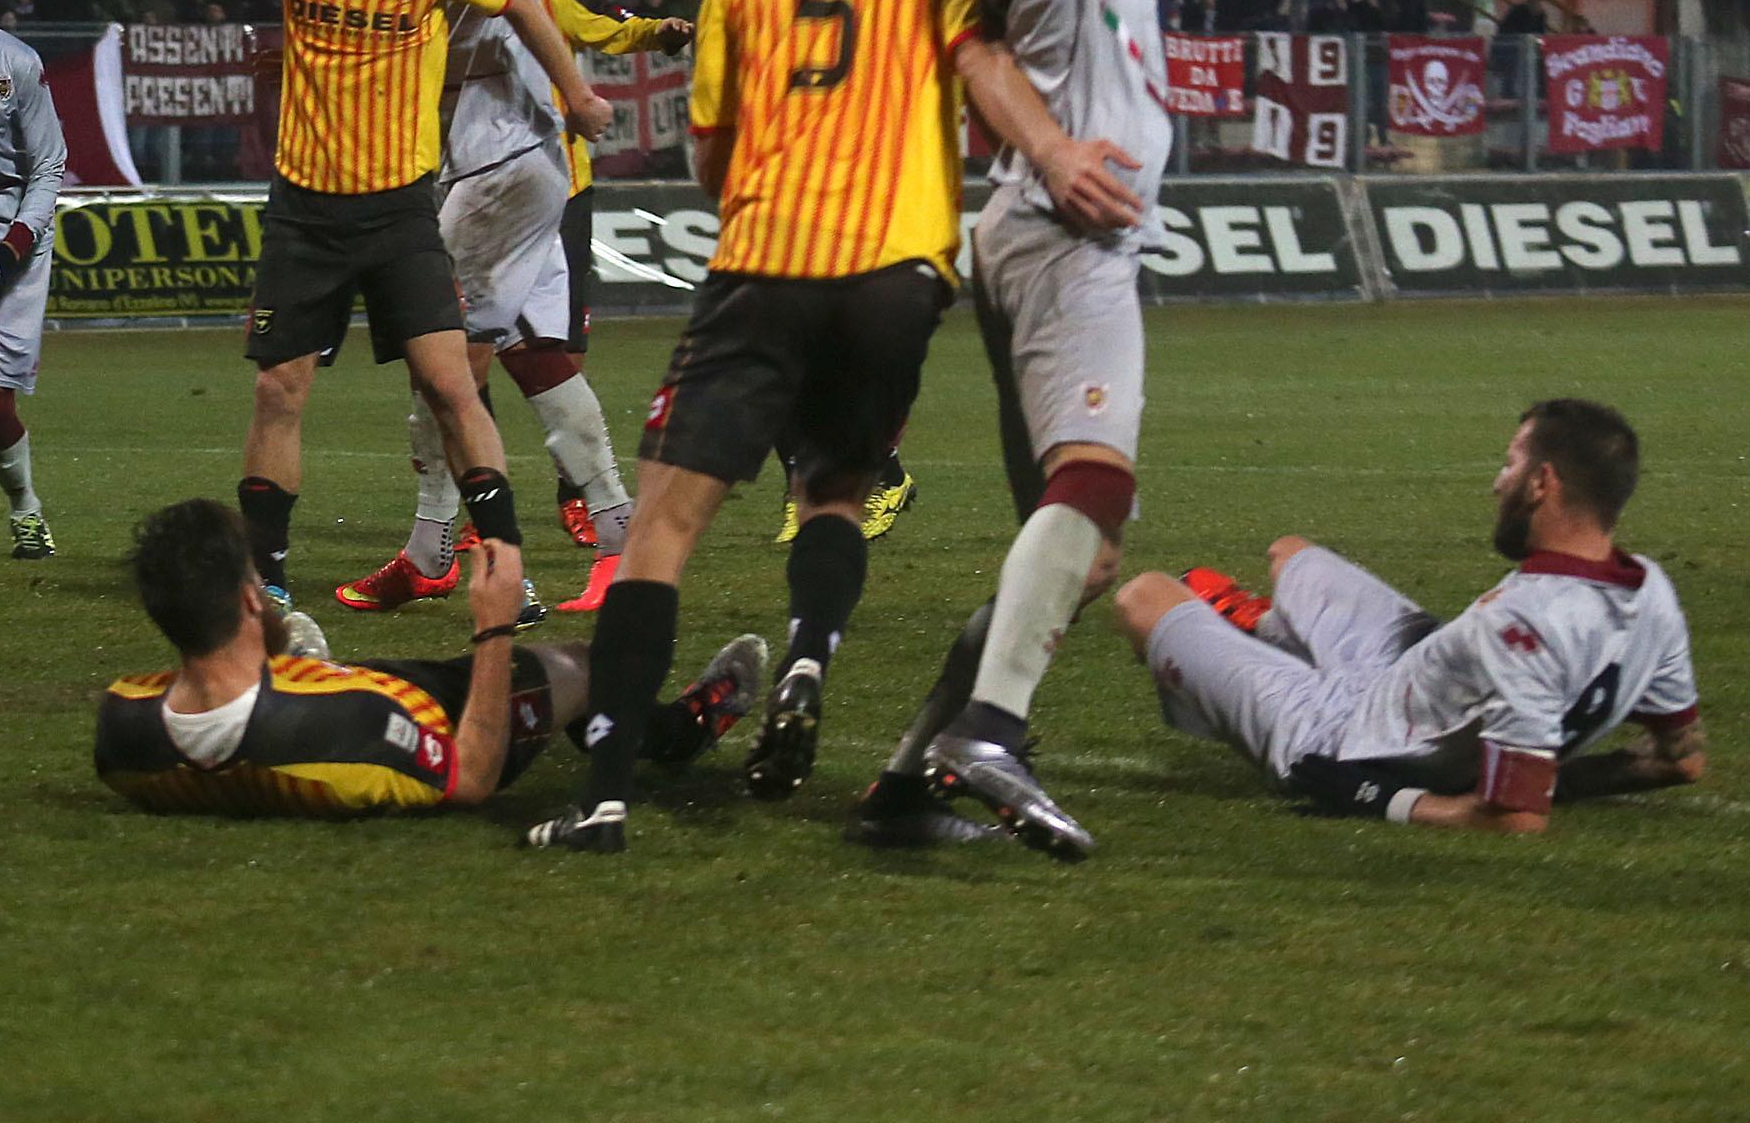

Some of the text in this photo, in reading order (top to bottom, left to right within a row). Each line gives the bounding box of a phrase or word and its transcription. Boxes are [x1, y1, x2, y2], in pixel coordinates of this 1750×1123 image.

[1165, 36, 1243, 63] BRUTTI
[1140, 205, 1338, 275] SEL
[1384, 199, 1740, 272] DIESEL
